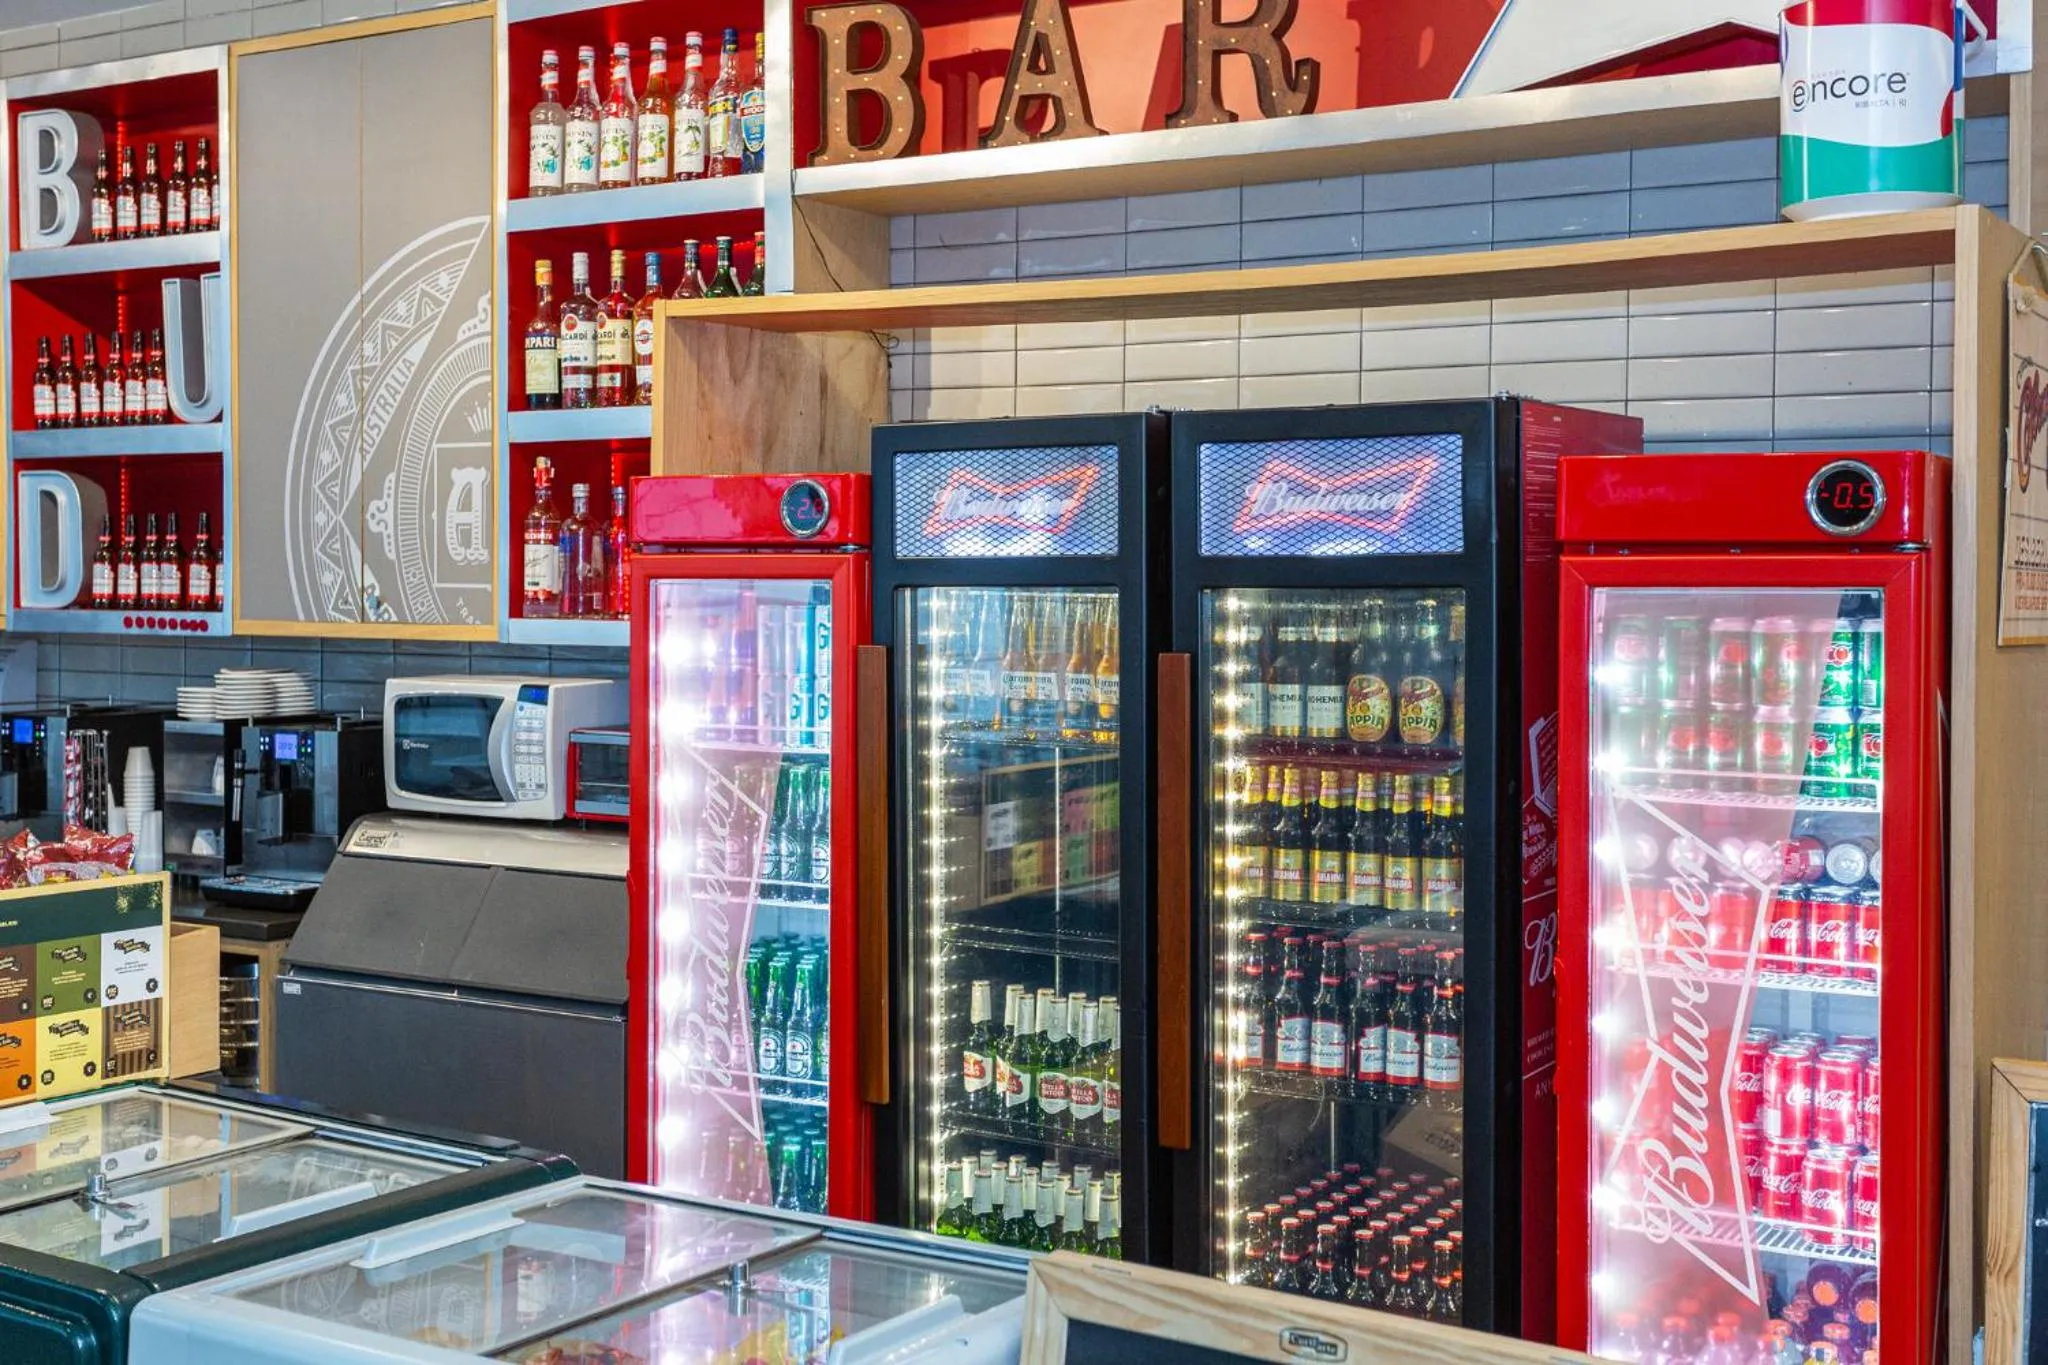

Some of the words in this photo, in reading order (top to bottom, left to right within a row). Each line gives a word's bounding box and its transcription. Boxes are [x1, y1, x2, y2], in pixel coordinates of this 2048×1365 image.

[1793, 72, 1907, 112] encore
[18, 108, 83, 250] B
[161, 272, 224, 424] U
[361, 357, 416, 463] AUSTRALIA
[18, 470, 84, 609] D
[688, 774, 733, 1095] Budweiser
[1638, 860, 1714, 1245] Budweiser
